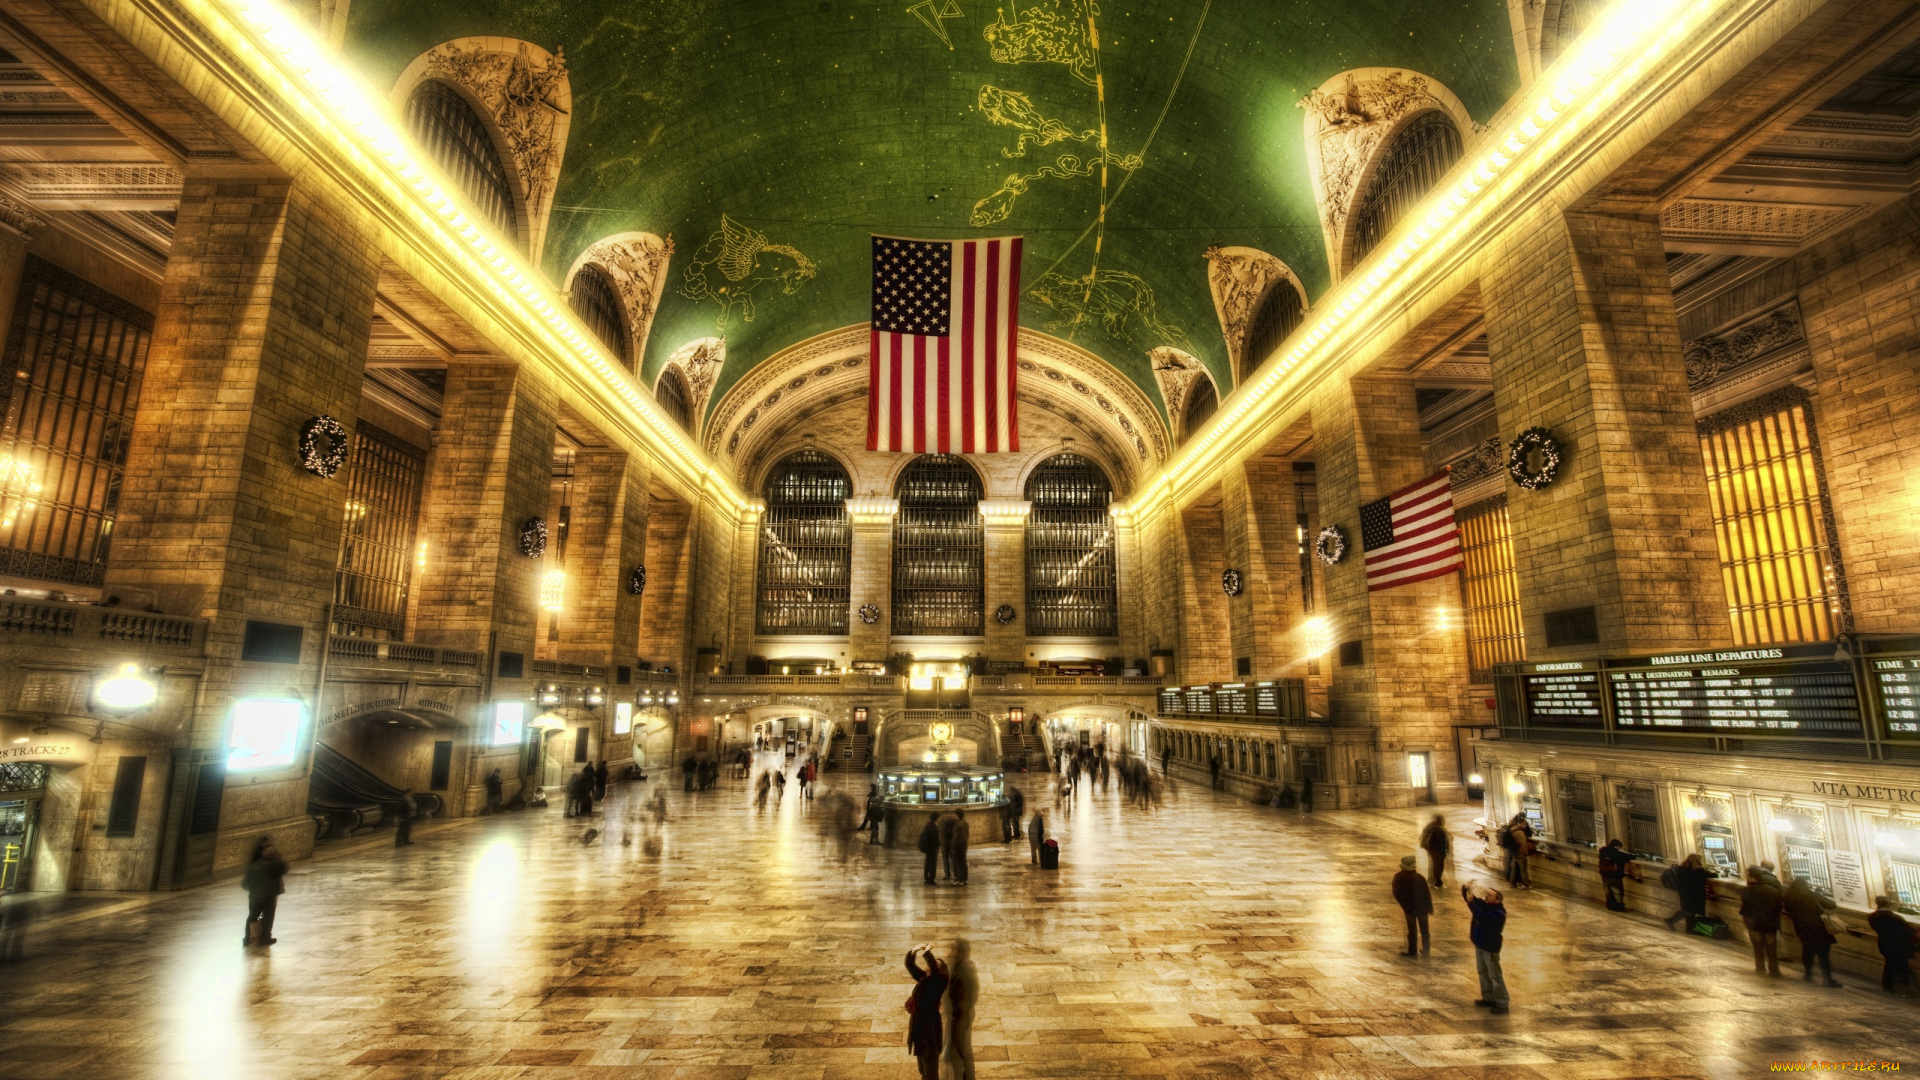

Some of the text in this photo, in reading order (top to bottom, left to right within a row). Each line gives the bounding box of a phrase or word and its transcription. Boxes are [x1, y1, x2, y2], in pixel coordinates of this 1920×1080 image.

[1651, 648, 1783, 665] HARLEM LINE DEPARTURES
[1536, 662, 1583, 671] INFORMATION
[1875, 660, 1904, 669] TIME
[1646, 671, 1692, 679] DESTINATION
[1701, 669, 1740, 677] REMARKS
[1881, 673, 1908, 682] 10:32
[1755, 678, 1772, 686] STOP
[1775, 688, 1794, 696] STOP
[1883, 685, 1910, 694] 11:09
[432, 700, 453, 713] STREET
[1758, 699, 1775, 707] STOP
[1885, 698, 1913, 706] 11:45
[334, 703, 365, 720] METLIFE
[366, 698, 399, 710] BUILDING
[1781, 720, 1800, 728] STOP
[1890, 722, 1918, 732] 12:30
[11, 745, 57, 756] TRACKS
[58, 746, 70, 755] 27
[1812, 781, 1851, 797] MTA
